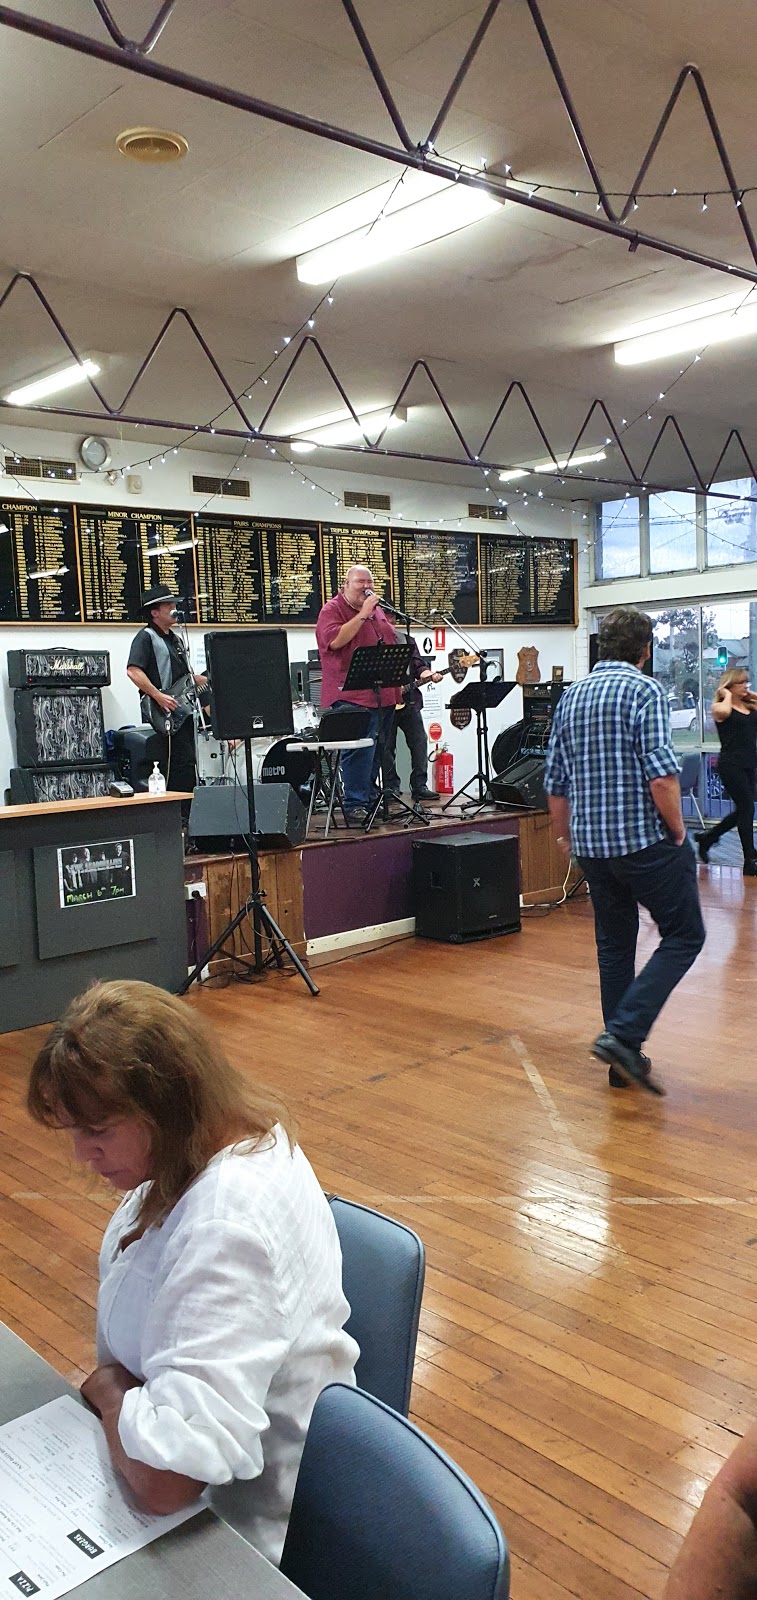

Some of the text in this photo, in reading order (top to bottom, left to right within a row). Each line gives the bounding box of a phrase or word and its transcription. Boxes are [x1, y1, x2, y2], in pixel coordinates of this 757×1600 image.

[2, 503, 38, 512] CHAMPION
[107, 511, 162, 521] MINOR CHAMPION
[251, 521, 282, 529] CHAMPIONS
[49, 659, 84, 670] Marshall
[262, 765, 286, 777] metro
[66, 892, 93, 903] MARCH
[73, 1533, 97, 1553] BURGERS
[16, 1575, 33, 1592] PIZZA
